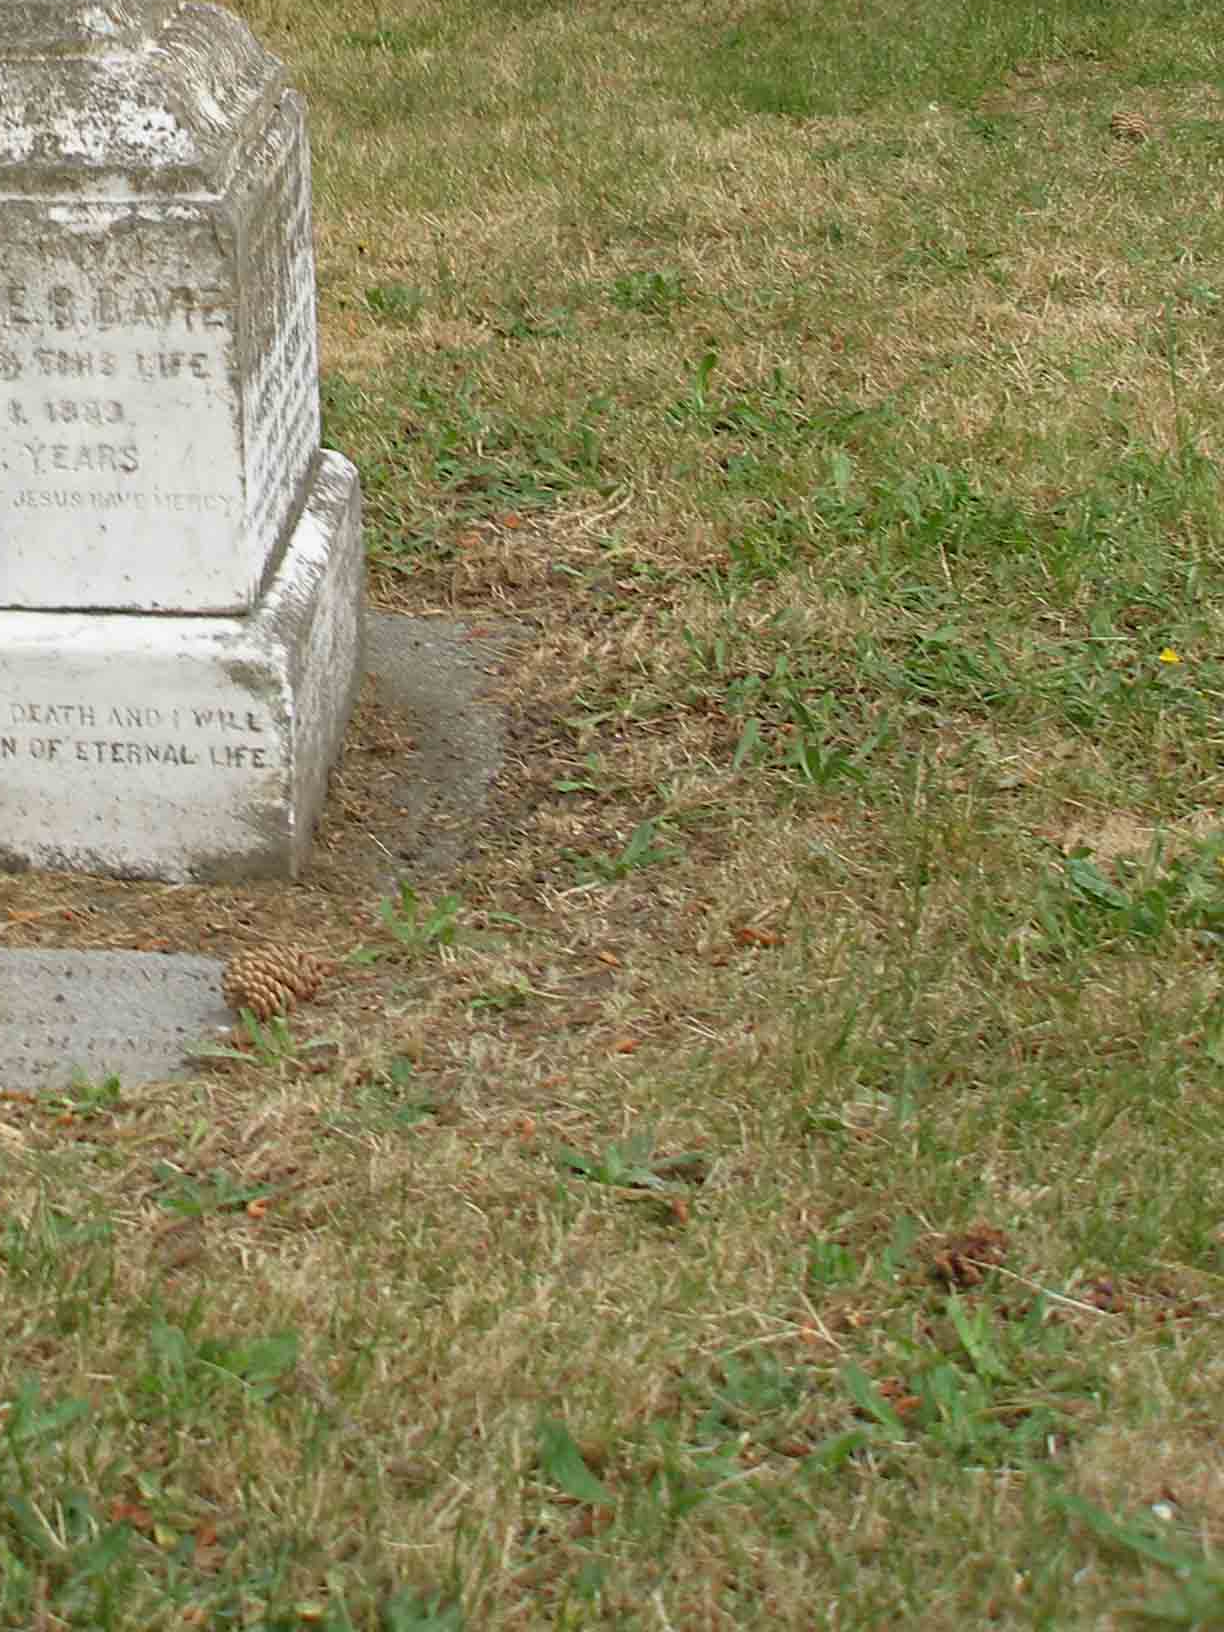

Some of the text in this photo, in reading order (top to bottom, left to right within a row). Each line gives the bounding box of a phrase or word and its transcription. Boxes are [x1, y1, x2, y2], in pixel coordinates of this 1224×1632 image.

[137, 351, 210, 379] LIFE
[24, 440, 140, 474] YEARS
[12, 488, 82, 509] JESUS
[89, 490, 145, 511] HAVE
[10, 701, 96, 728] DEATH
[109, 706, 161, 729] AND
[191, 709, 264, 733] WILL
[29, 738, 64, 762] OF
[75, 740, 197, 767] ETERNAL
